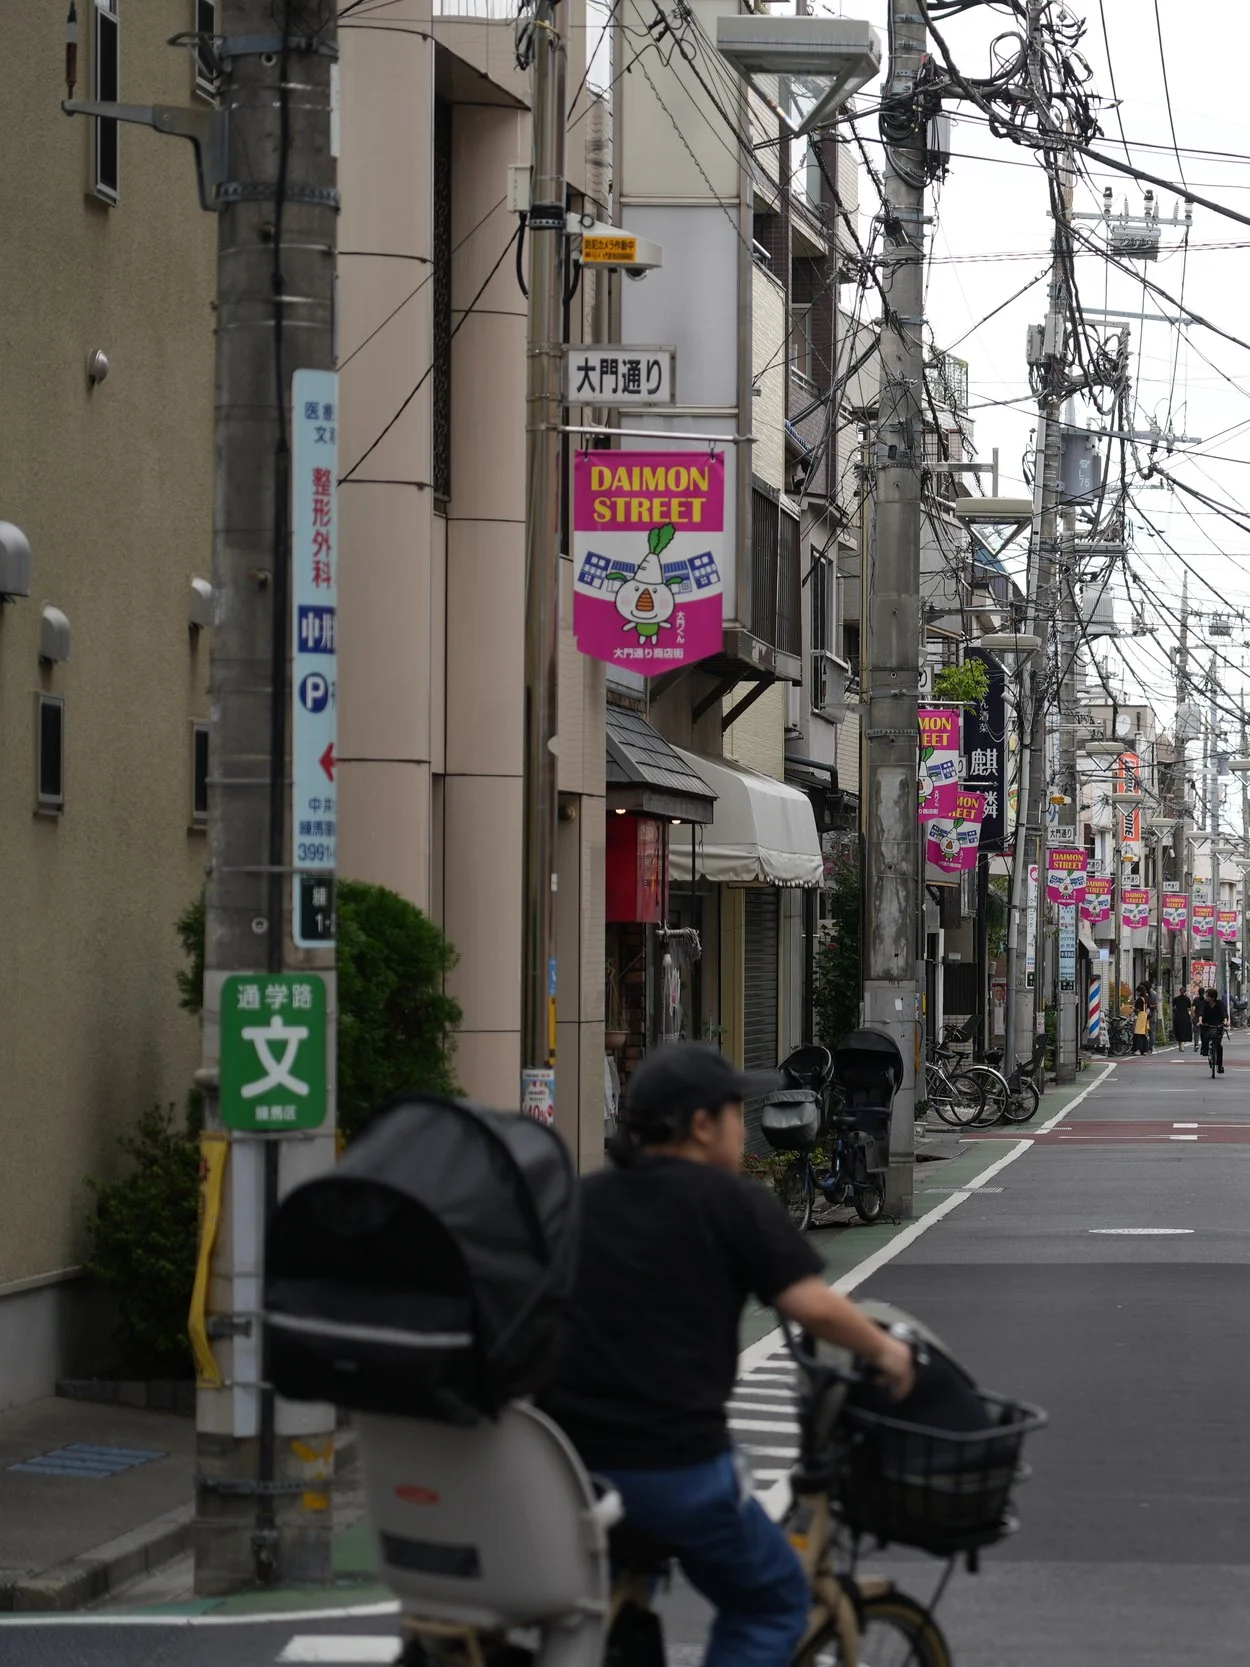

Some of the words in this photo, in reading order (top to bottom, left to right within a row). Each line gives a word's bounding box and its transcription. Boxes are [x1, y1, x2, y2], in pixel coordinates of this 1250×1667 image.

[576, 357, 662, 395] 大門通り
[591, 466, 709, 491] DAIMON
[593, 497, 706, 523] STREET
[312, 467, 332, 589] 整形外科
[676, 611, 685, 643] 大門くん
[613, 648, 684, 659] 大門通り商店街
[918, 733, 950, 746] EET
[1050, 828, 1072, 839] 大門通り
[1053, 853, 1084, 861] DAIMON
[236, 983, 313, 1011] 通学路
[255, 1105, 297, 1121] 練馬区
